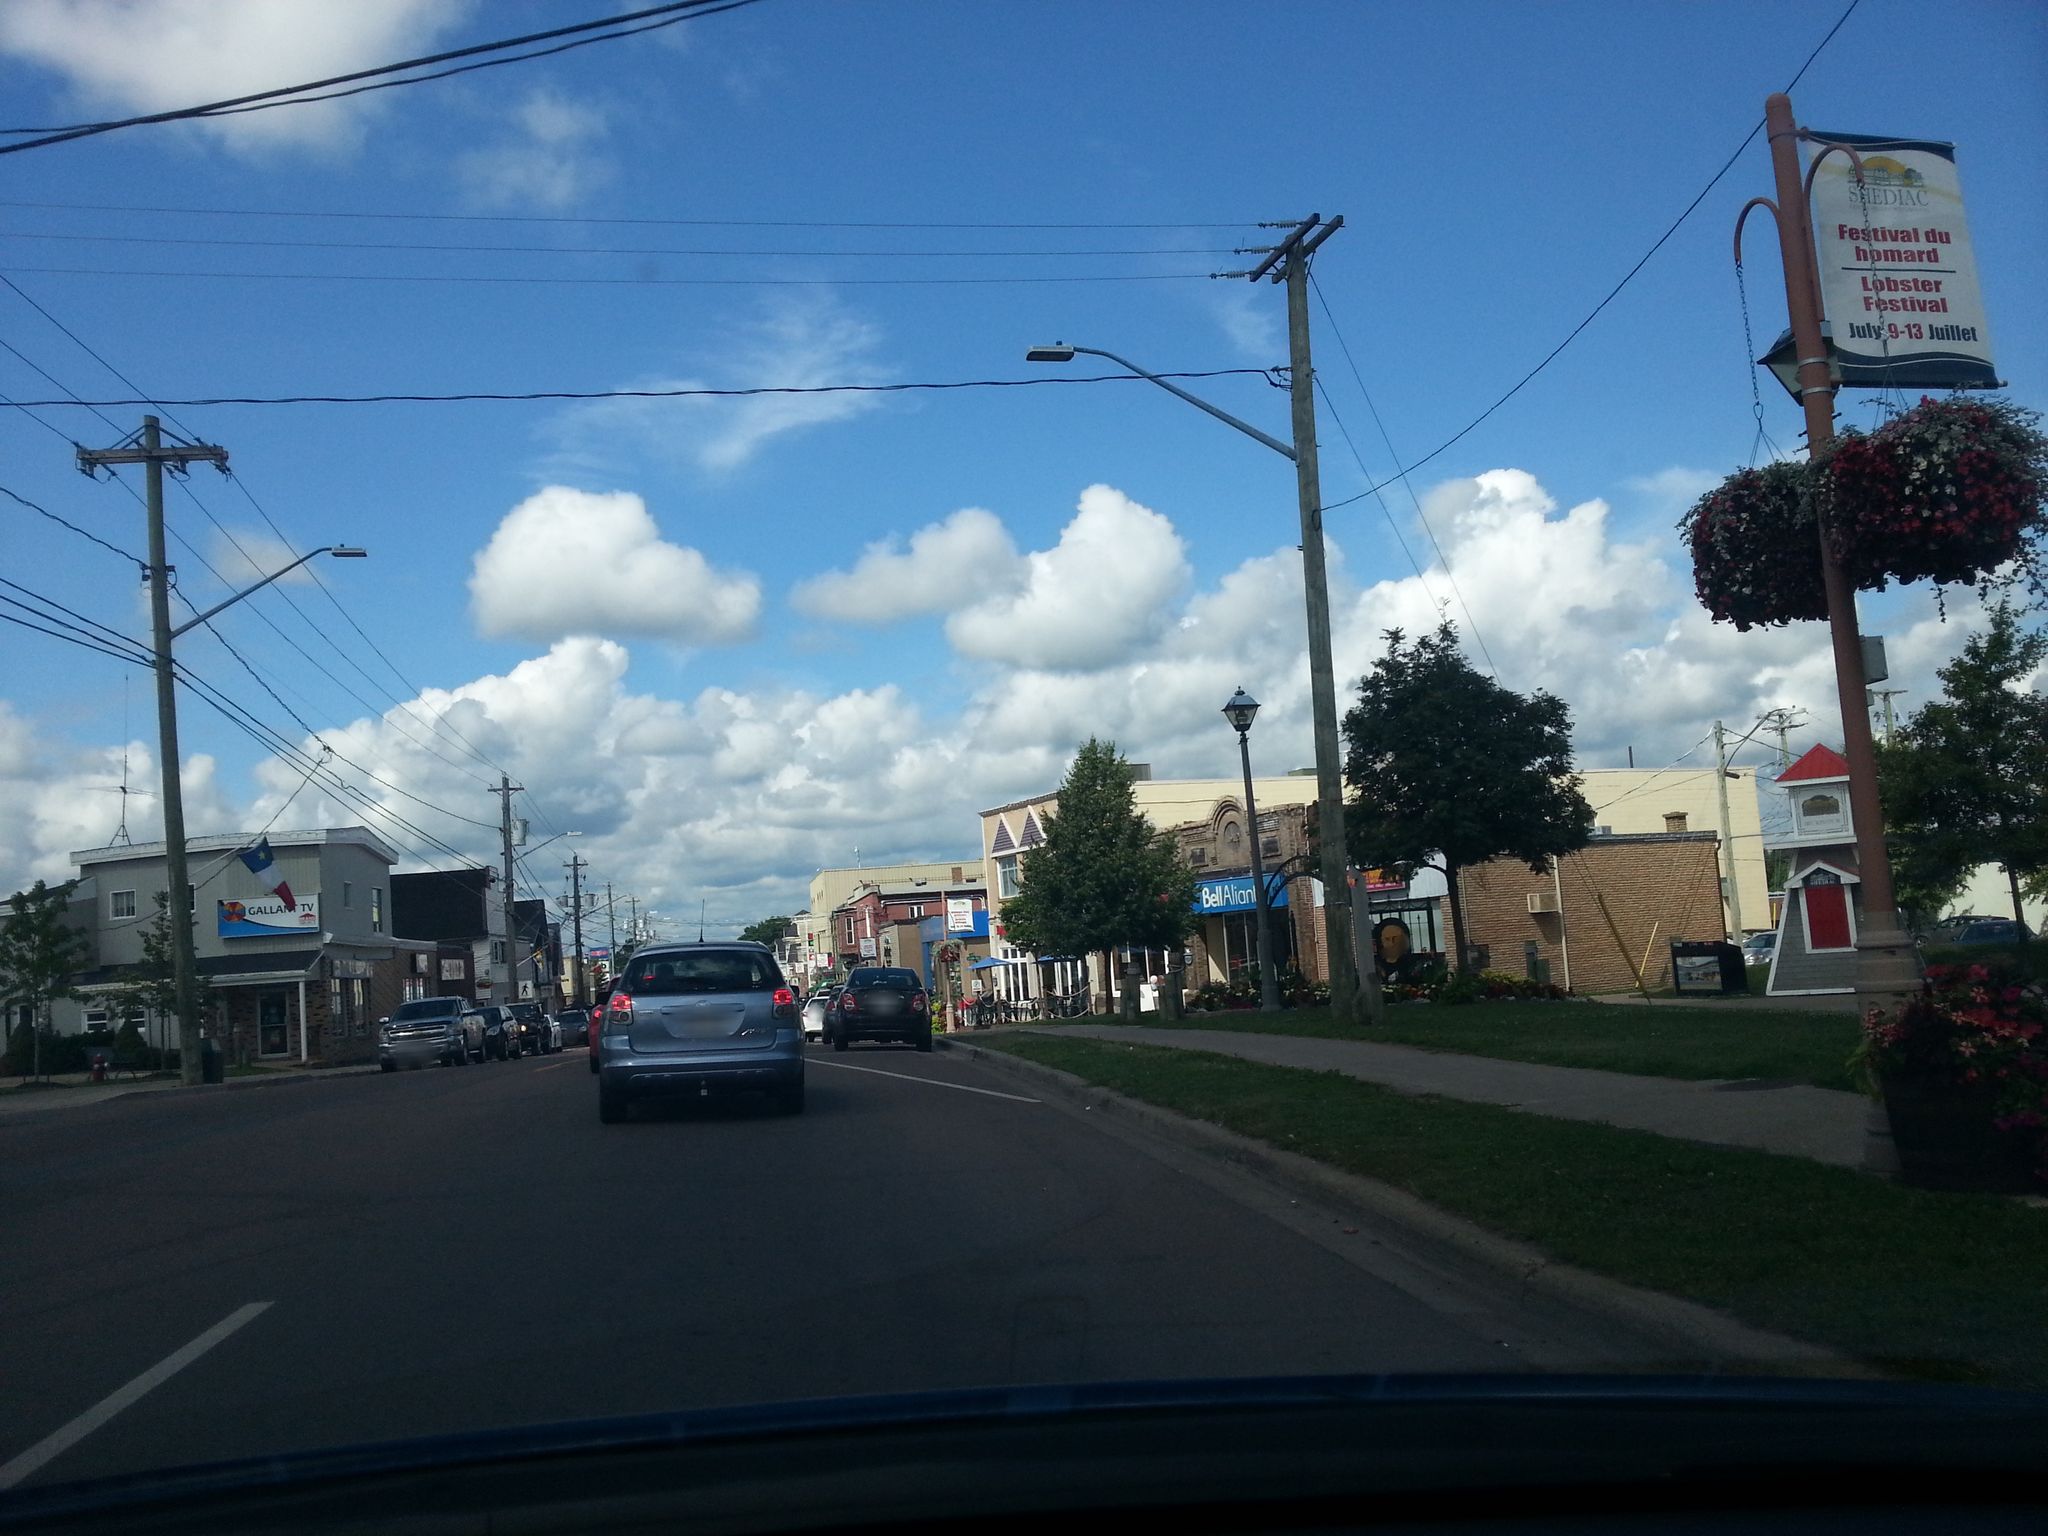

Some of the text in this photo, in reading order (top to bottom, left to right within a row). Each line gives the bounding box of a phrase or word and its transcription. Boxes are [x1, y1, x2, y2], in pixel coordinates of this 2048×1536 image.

[1848, 184, 1929, 206] SHEDIAC
[1838, 223, 1951, 244] Festival du
[1855, 245, 1939, 263] homard
[1861, 276, 1942, 292] Lobster
[1863, 296, 1948, 313] Festival
[1849, 322, 1978, 342] July 9-13 Juillet
[300, 902, 314, 912] TV
